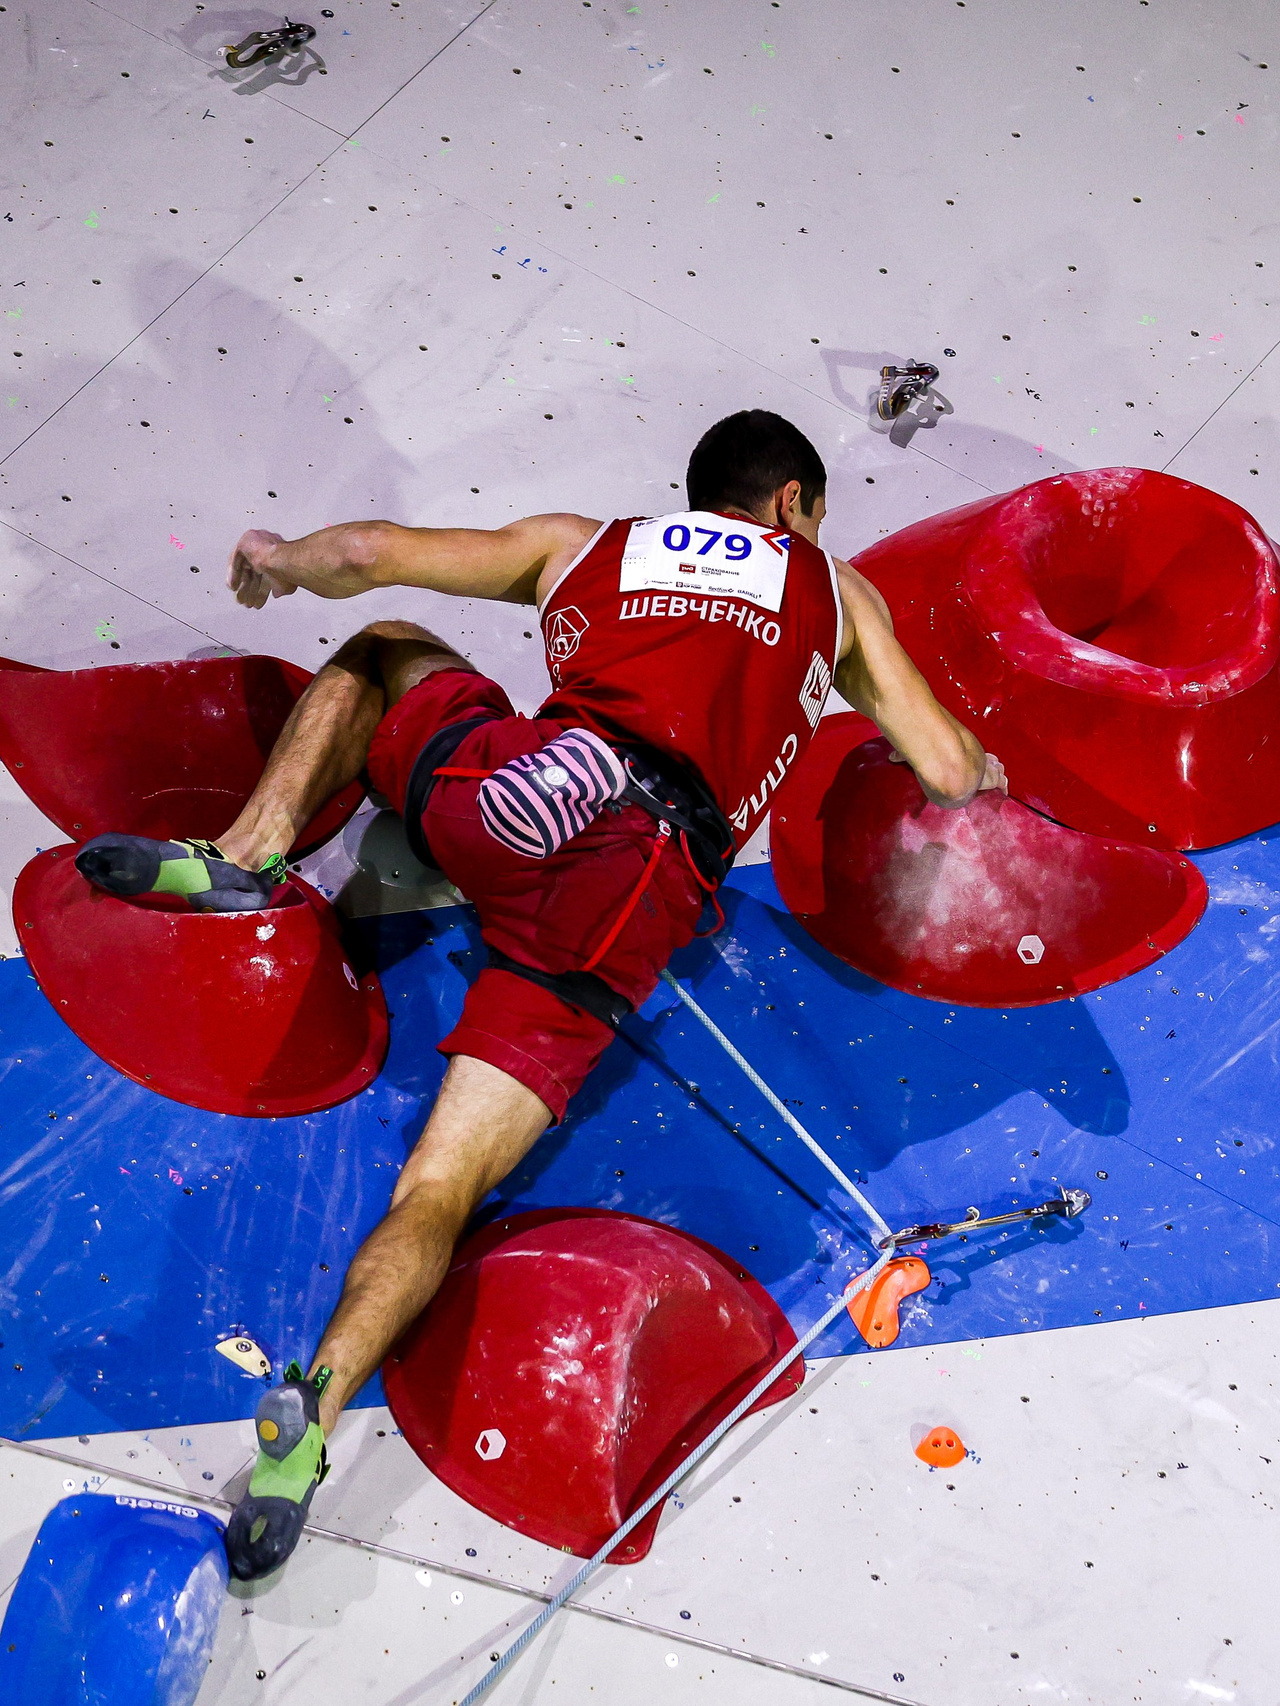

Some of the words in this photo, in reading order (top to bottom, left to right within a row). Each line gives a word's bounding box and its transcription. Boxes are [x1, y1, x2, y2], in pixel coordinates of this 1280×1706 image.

[663, 524, 752, 561] 079
[619, 595, 781, 646] ШЕВЧЕНКО
[728, 733, 798, 832] СПЛА
[115, 1495, 199, 1518] Cheeta
